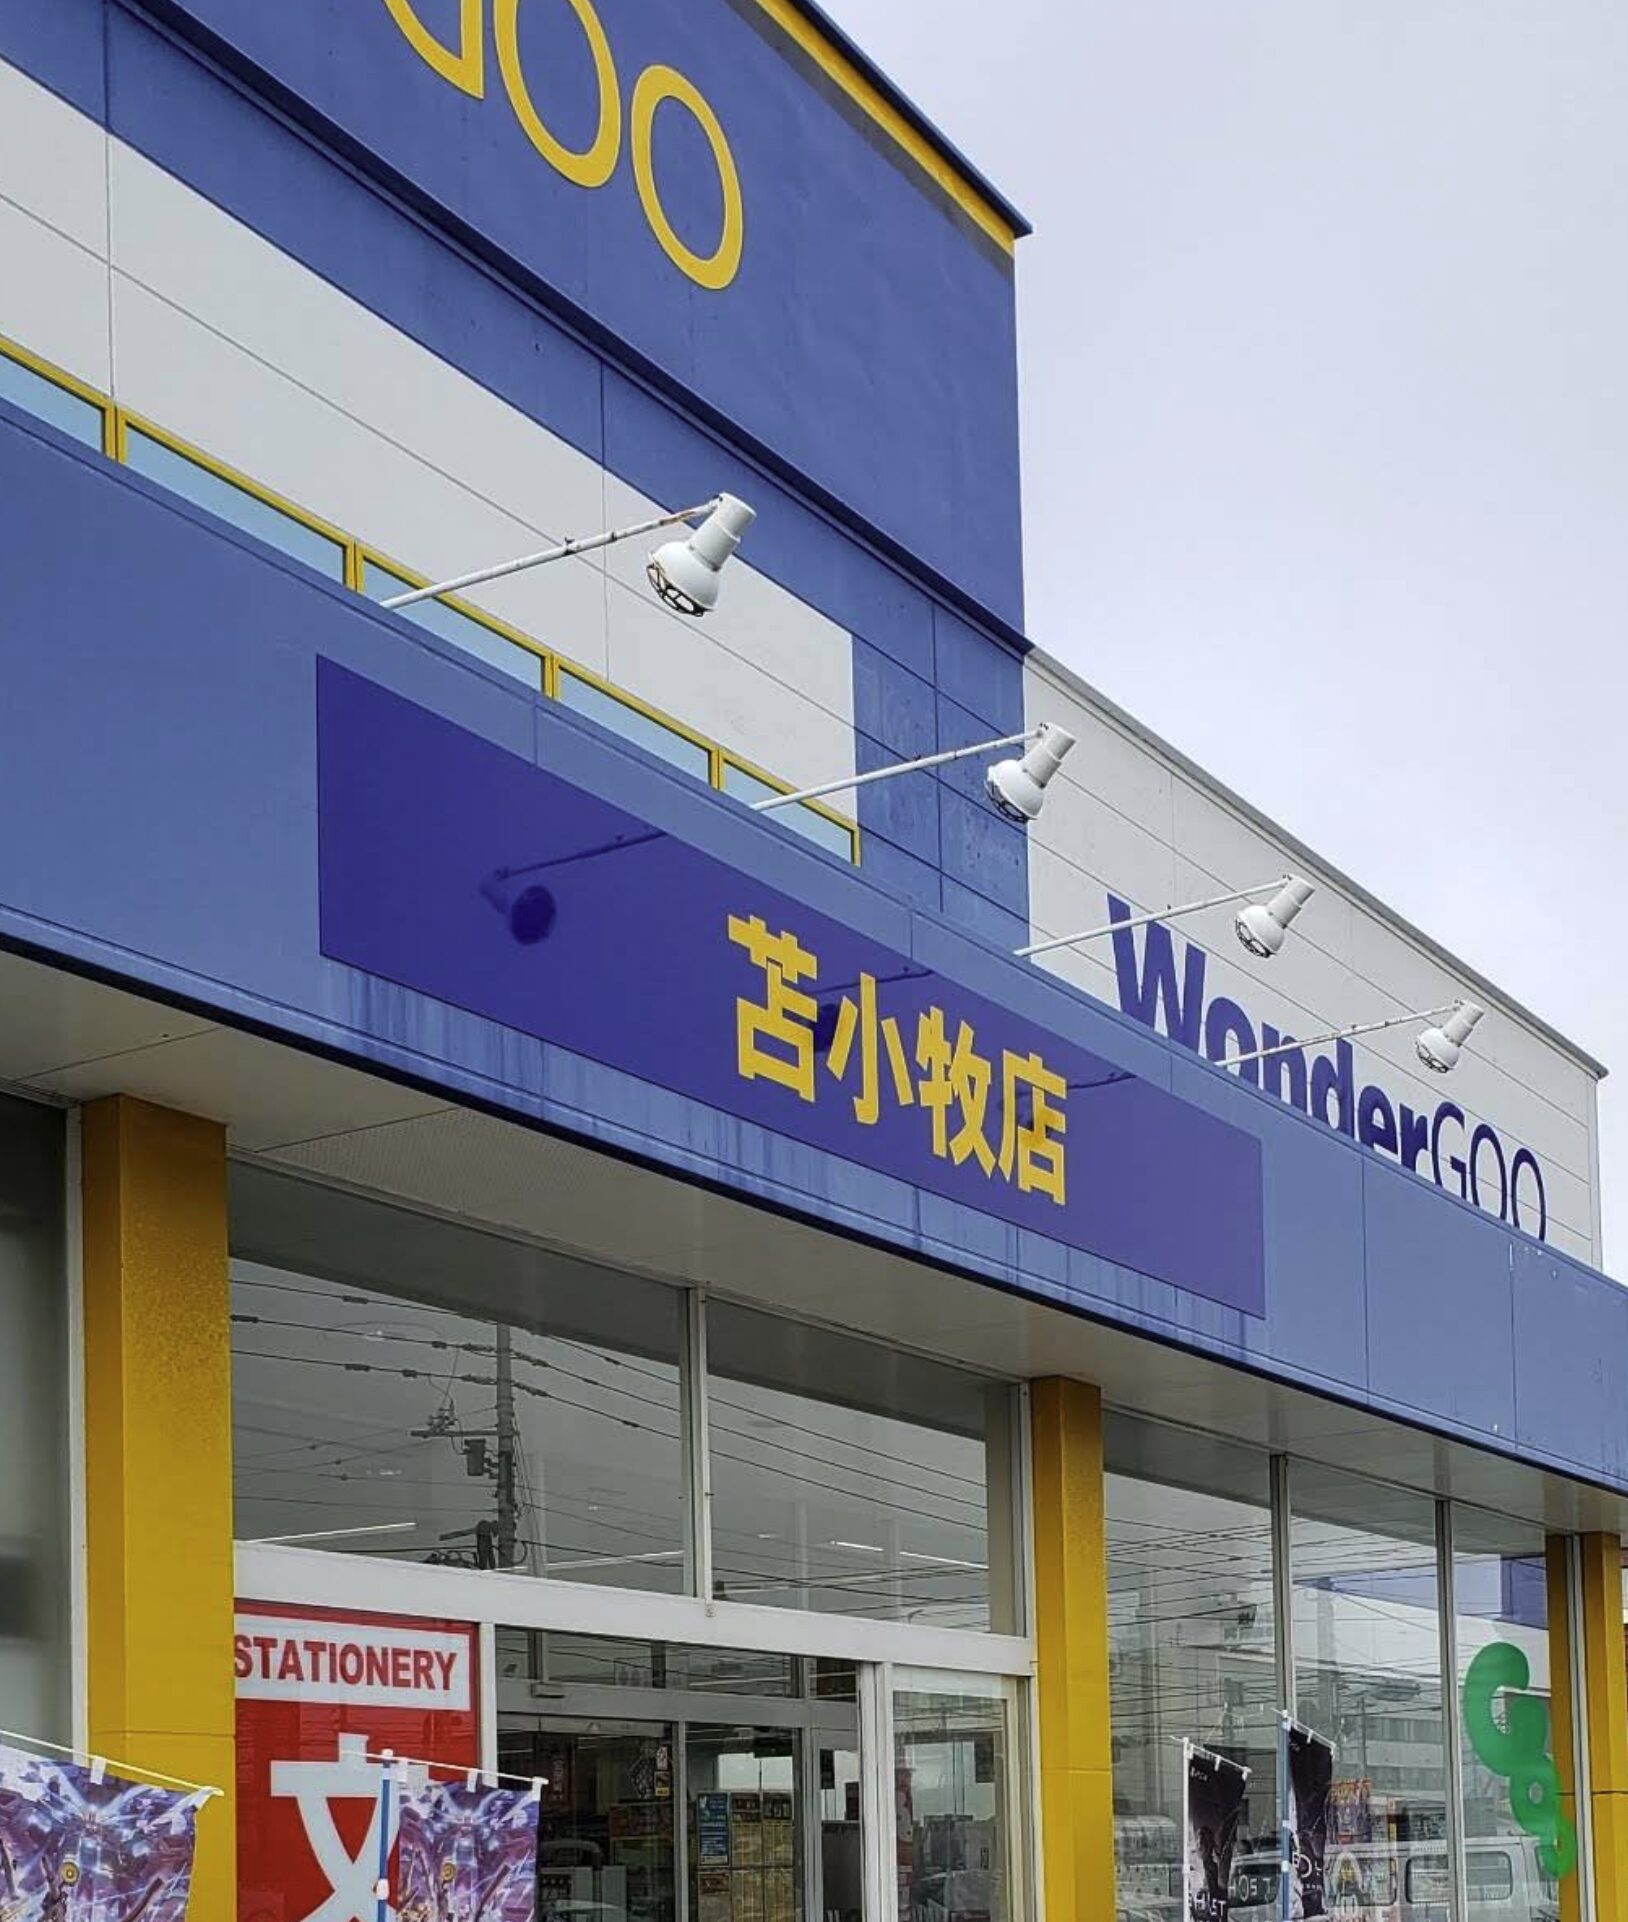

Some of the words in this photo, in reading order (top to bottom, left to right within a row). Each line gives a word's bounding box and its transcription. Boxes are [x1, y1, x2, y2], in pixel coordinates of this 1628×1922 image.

[727, 914, 1067, 1206] 苫小牧店
[1107, 893, 1546, 1241] WonderGOO
[234, 1634, 457, 1691] STATIONERY
[270, 1732, 429, 1922] 文
